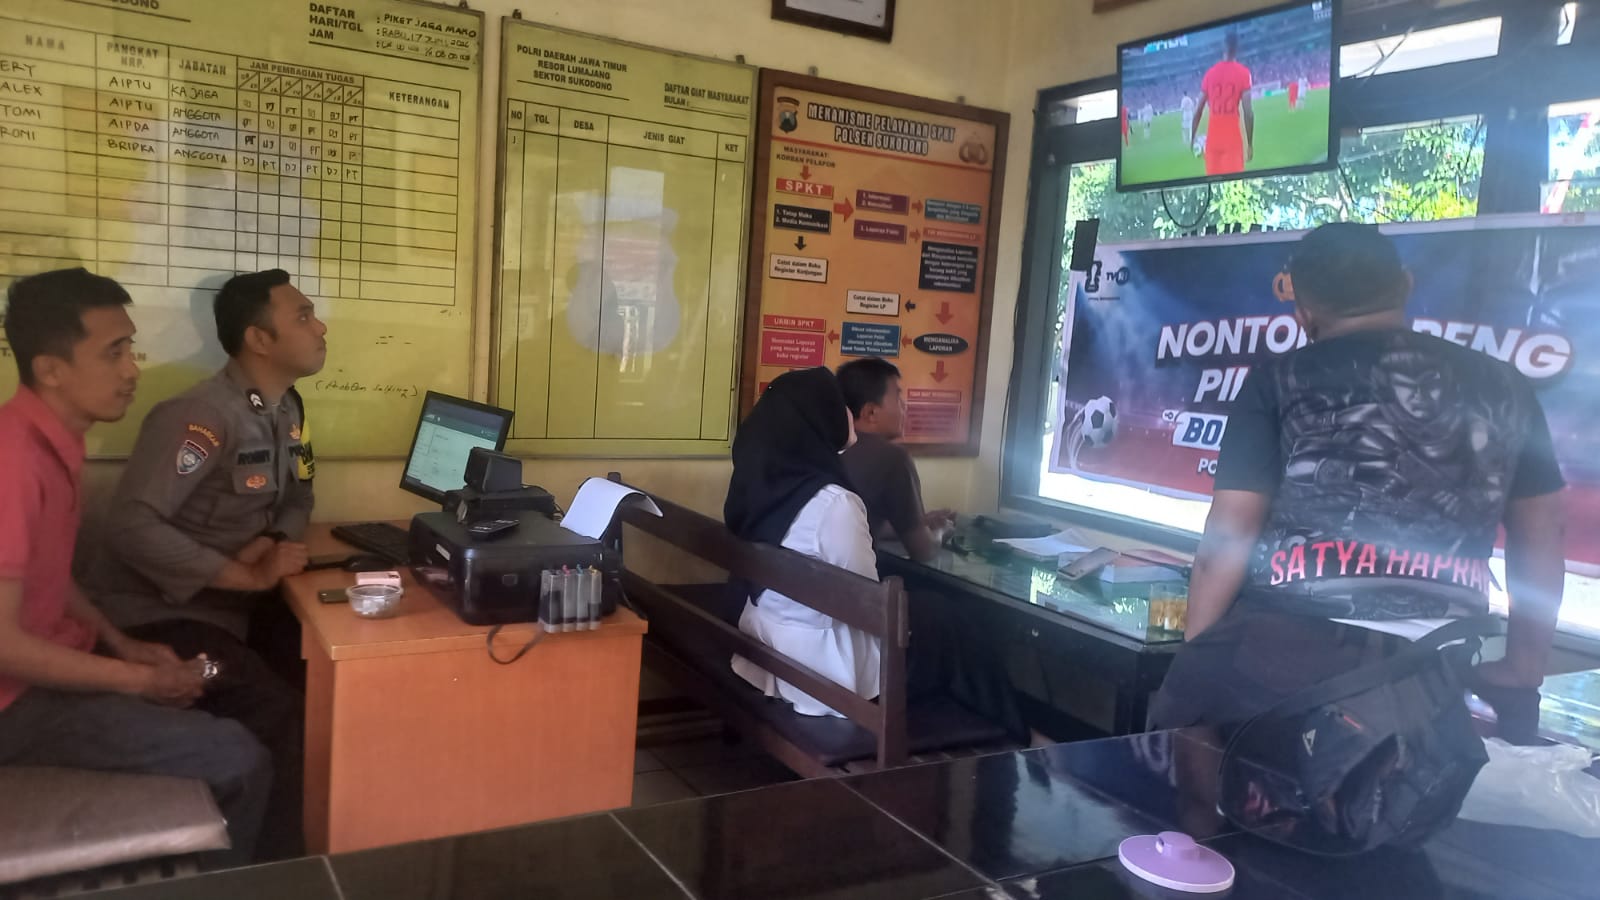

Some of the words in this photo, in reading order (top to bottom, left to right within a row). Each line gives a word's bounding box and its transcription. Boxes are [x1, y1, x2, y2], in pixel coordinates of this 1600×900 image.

[309, 2, 356, 19] DAFTAR
[309, 15, 364, 32] HARI/TGL
[384, 13, 412, 26] PIKET
[414, 19, 442, 32] JAGA
[445, 26, 477, 38] MAKO
[25, 34, 64, 50] NAMA
[309, 28, 334, 40] JAM
[106, 42, 158, 59] PANGKAT
[516, 44, 542, 58] POLRI
[544, 49, 576, 64] DAERAH
[578, 56, 601, 67] JAWA
[602, 60, 627, 72] TIMUR
[178, 57, 226, 76] JABATAN
[250, 62, 268, 70] JAM
[272, 64, 323, 79] PEMBAGIAN
[326, 72, 354, 84] TUGAS
[538, 60, 565, 72] RESOR
[568, 65, 610, 80] LUMAJANG
[0, 81, 42, 96] ALEX
[109, 76, 152, 90] AIPTU
[533, 70, 566, 84] SEKTOR
[568, 76, 612, 92] SUKODONO
[388, 91, 450, 110] KETERANGAN
[664, 82, 690, 96] DAFTAR
[690, 87, 706, 98] GIAT
[707, 90, 750, 104] MASYARAKAT
[1212, 82, 1236, 114] 22
[0, 104, 41, 120] TOMI
[109, 97, 153, 112] AIPTU
[173, 107, 221, 121] ANGGOTA
[510, 110, 522, 120] NO
[534, 113, 550, 124] TGL
[108, 118, 150, 132] AIPDA
[574, 119, 594, 132] DESA
[806, 102, 872, 130] MEKANISME
[873, 114, 930, 138] PELAYANAN
[930, 124, 956, 143] SPKT
[172, 127, 220, 141] ANGGOTA
[643, 130, 665, 142] JENIS
[668, 134, 686, 144] GIAT
[834, 126, 874, 148] POLSEK
[875, 132, 928, 156] SUKODONO
[108, 138, 156, 154] BRIPKA
[724, 143, 739, 152] KET
[174, 148, 228, 164] ANGGOTA
[785, 180, 824, 195] SPKT
[1157, 314, 1308, 360] NONTO
[1270, 541, 1378, 586] SATYA
